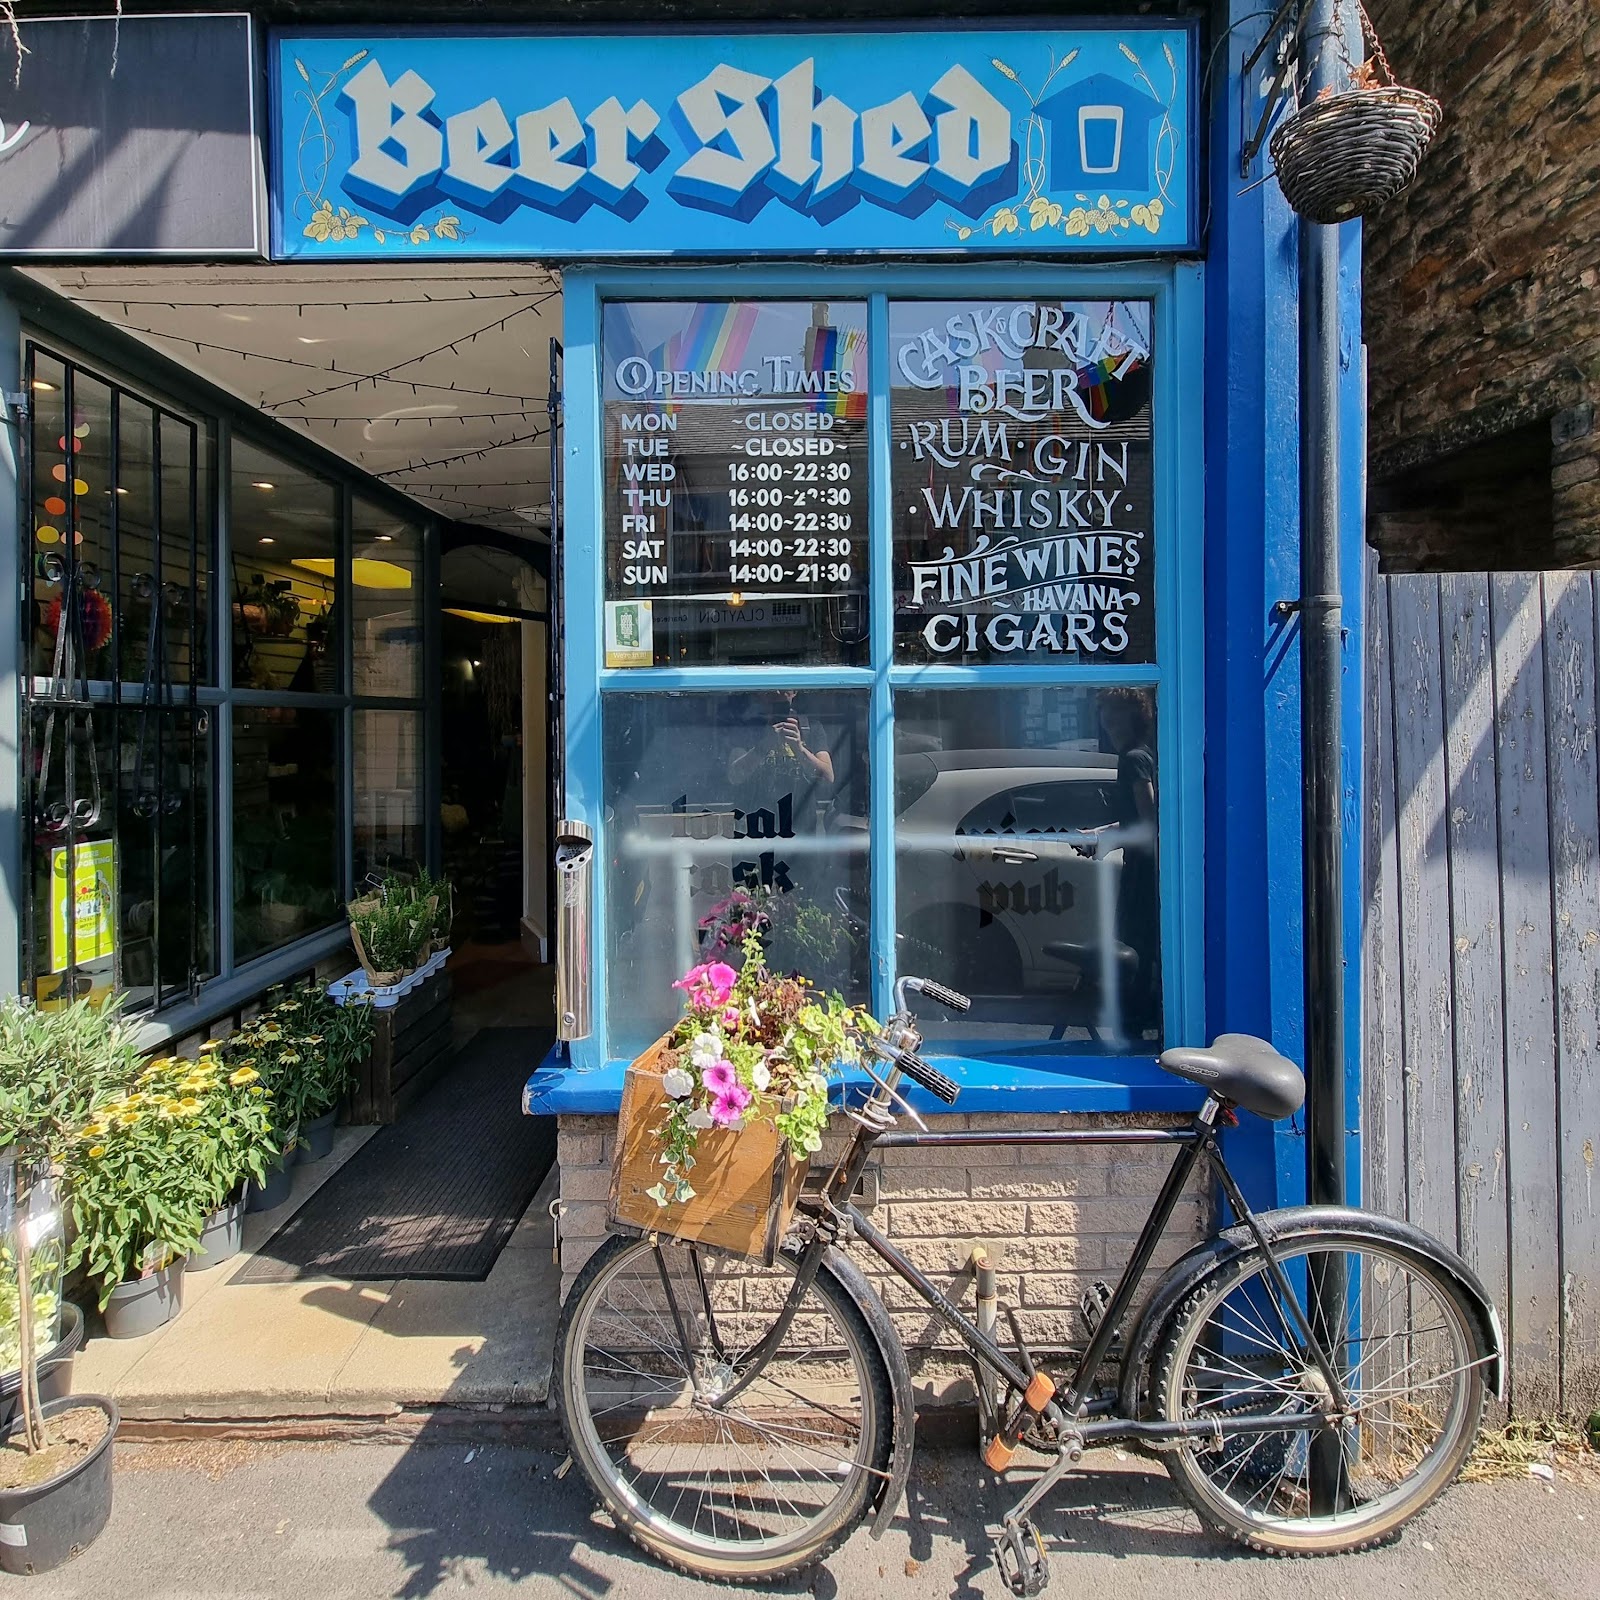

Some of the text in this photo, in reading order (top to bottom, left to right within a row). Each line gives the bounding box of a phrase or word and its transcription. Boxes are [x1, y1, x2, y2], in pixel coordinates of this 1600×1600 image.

[341, 56, 1011, 208] Beer Shed
[898, 306, 1025, 389] CASK
[1009, 304, 1150, 382] CRAFT
[956, 365, 1111, 429] BEER
[621, 413, 677, 431] MON
[623, 438, 669, 457] TUE
[1034, 435, 1129, 487] GIN
[623, 463, 676, 481] WED
[623, 488, 671, 507] THU
[921, 484, 1122, 529] WHISKY
[622, 514, 655, 533] FRI
[622, 540, 665, 559] SAT
[623, 565, 668, 584] SUN
[911, 536, 1141, 606] FINE WINES
[1021, 584, 1140, 612] HAVANA
[921, 613, 1130, 652] CIGARS
